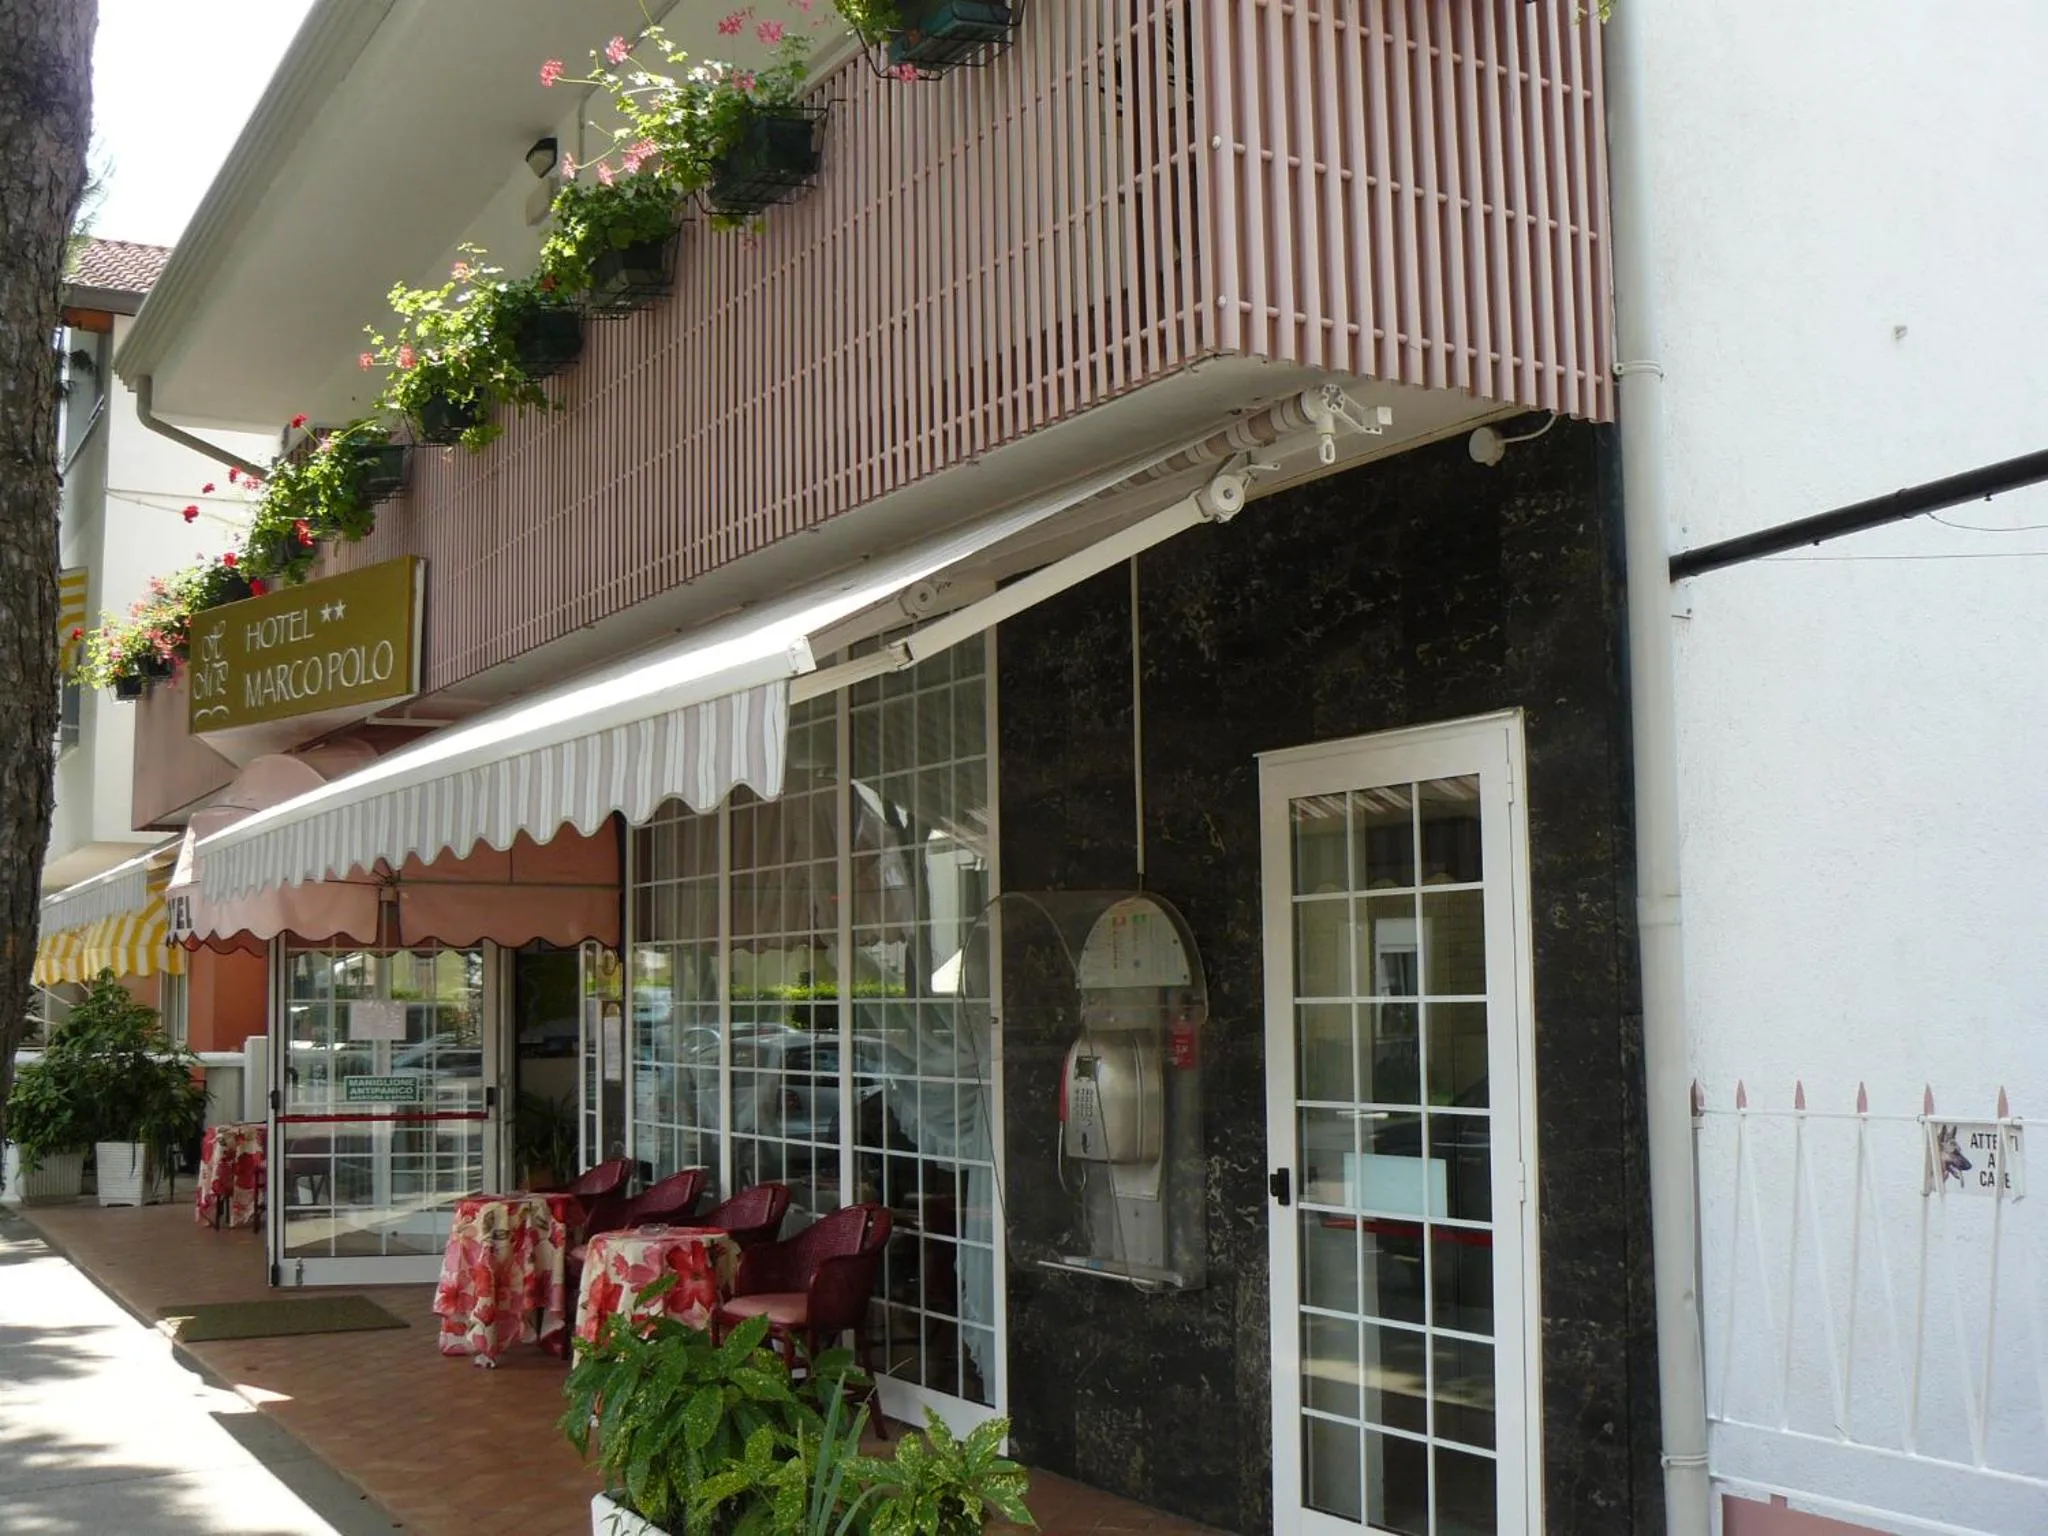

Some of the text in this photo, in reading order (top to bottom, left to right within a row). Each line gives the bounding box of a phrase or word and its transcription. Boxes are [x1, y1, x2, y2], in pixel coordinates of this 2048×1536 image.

[246, 608, 315, 652] HOTEL
[245, 639, 394, 709] MARCO POLO
[1979, 1171, 2011, 1189] CAE
